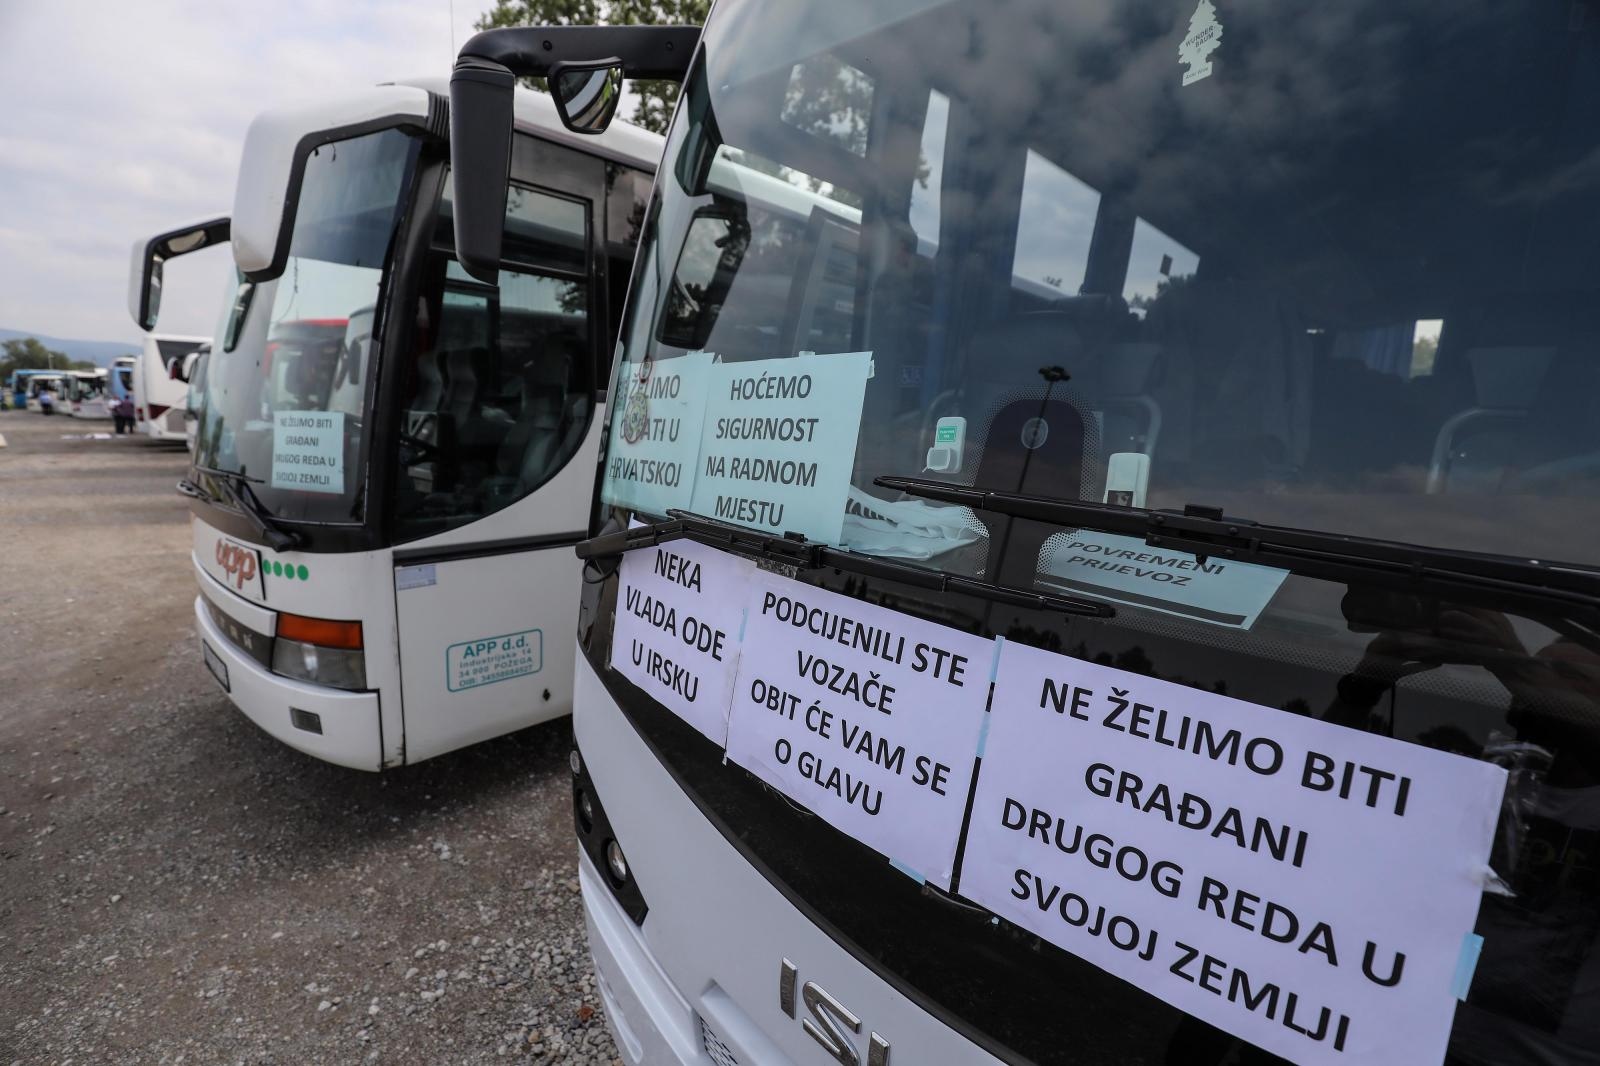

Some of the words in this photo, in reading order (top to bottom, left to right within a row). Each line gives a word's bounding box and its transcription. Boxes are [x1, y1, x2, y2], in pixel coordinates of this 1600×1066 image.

[730, 370, 812, 401] HOĆEMO
[316, 418, 332, 429] BITI
[669, 418, 681, 442] U
[716, 417, 819, 443] SIGURNOST
[302, 455, 326, 466] REDA
[328, 457, 336, 467] U
[610, 457, 682, 488] HRVATSKOJ
[705, 456, 725, 478] NA
[730, 457, 818, 487] RADNOM
[298, 473, 330, 485] ZEMLJI
[714, 495, 784, 527] MJESTU
[654, 549, 701, 593] NEKA
[1066, 555, 1192, 586] PRIJEVOZ
[1067, 542, 1225, 575] POVREMENI
[625, 585, 676, 637] VLADA
[682, 617, 726, 662] ODE
[762, 592, 905, 665] PODCIJENILI
[911, 643, 968, 687] STE
[463, 641, 497, 659] APP
[502, 635, 529, 651] d.d.
[494, 656, 533, 671] POŽEGA
[632, 639, 643, 666] U
[647, 649, 698, 702] IRSKU
[798, 650, 896, 715] VOZAČE
[751, 679, 801, 721] OBIT
[805, 700, 834, 739] ĆE
[841, 720, 906, 775] VAM
[912, 756, 950, 796] SE
[1039, 678, 1093, 721] NE
[1102, 687, 1284, 775] ŽELIMO
[1301, 751, 1412, 817] BITI
[775, 738, 792, 764] O
[798, 752, 883, 816] GLAVU
[1085, 762, 1309, 868] GRAĐANI
[1001, 797, 1184, 898] DRUGOG
[1197, 876, 1339, 967] REDA
[1362, 941, 1406, 987] U
[1010, 869, 1158, 962] SVOJOJ
[1169, 940, 1351, 1052] ZEMLJI
